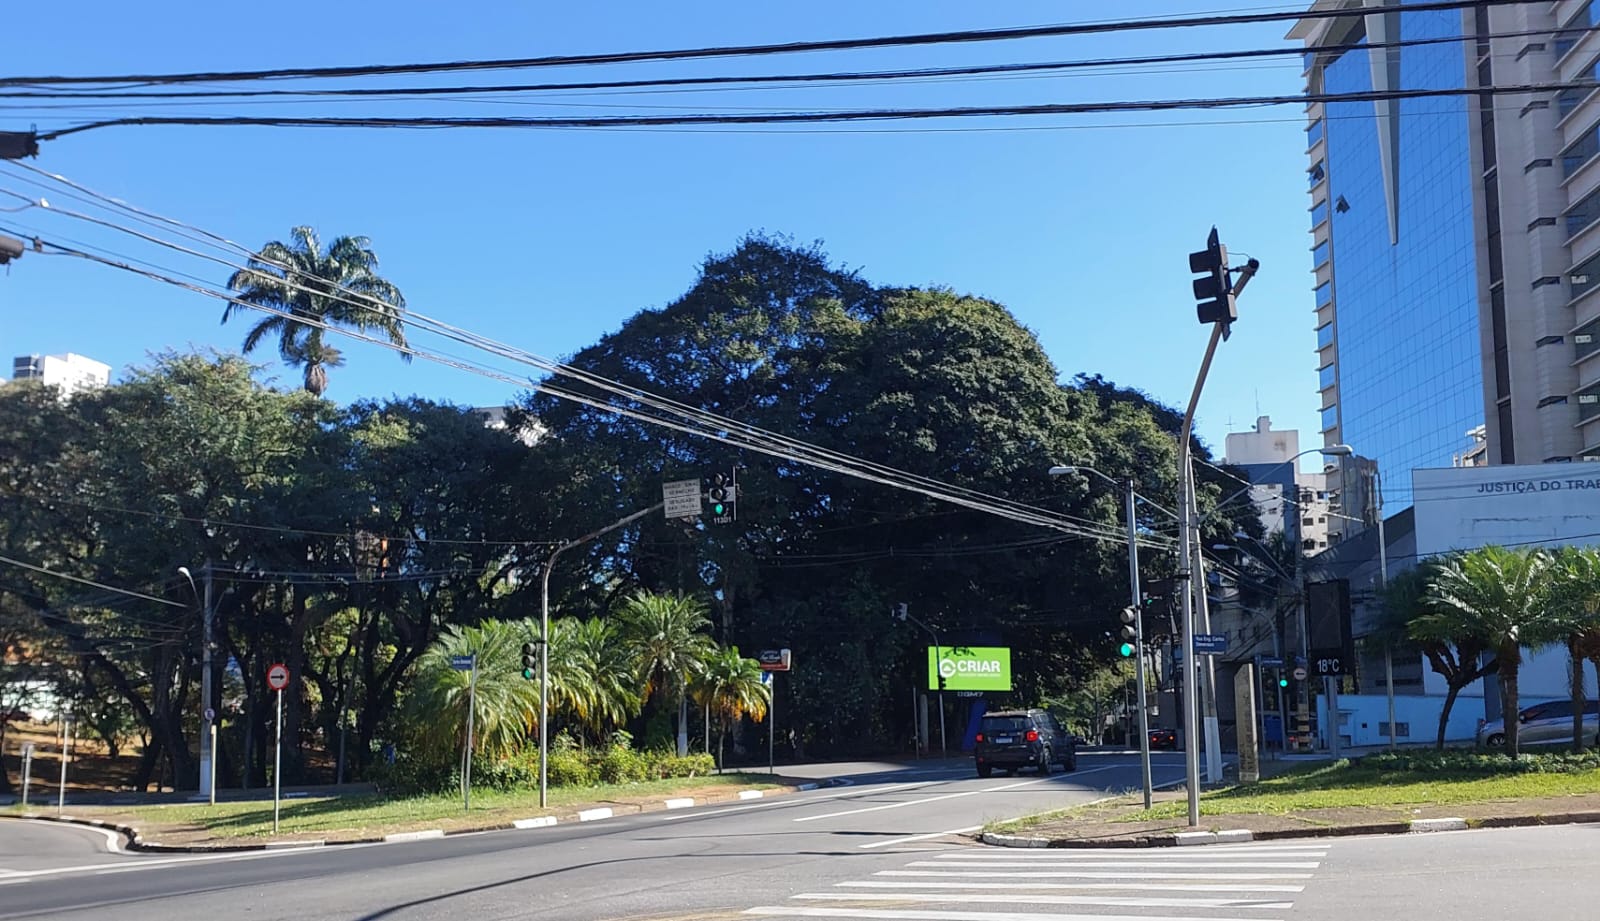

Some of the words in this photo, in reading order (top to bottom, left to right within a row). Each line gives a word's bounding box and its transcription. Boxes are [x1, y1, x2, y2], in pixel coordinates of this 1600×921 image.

[1477, 481, 1537, 494] JUSTIÇA
[1540, 480, 1561, 491] DO
[957, 659, 1001, 673] CRIAR
[1317, 658, 1340, 673] 18°C
